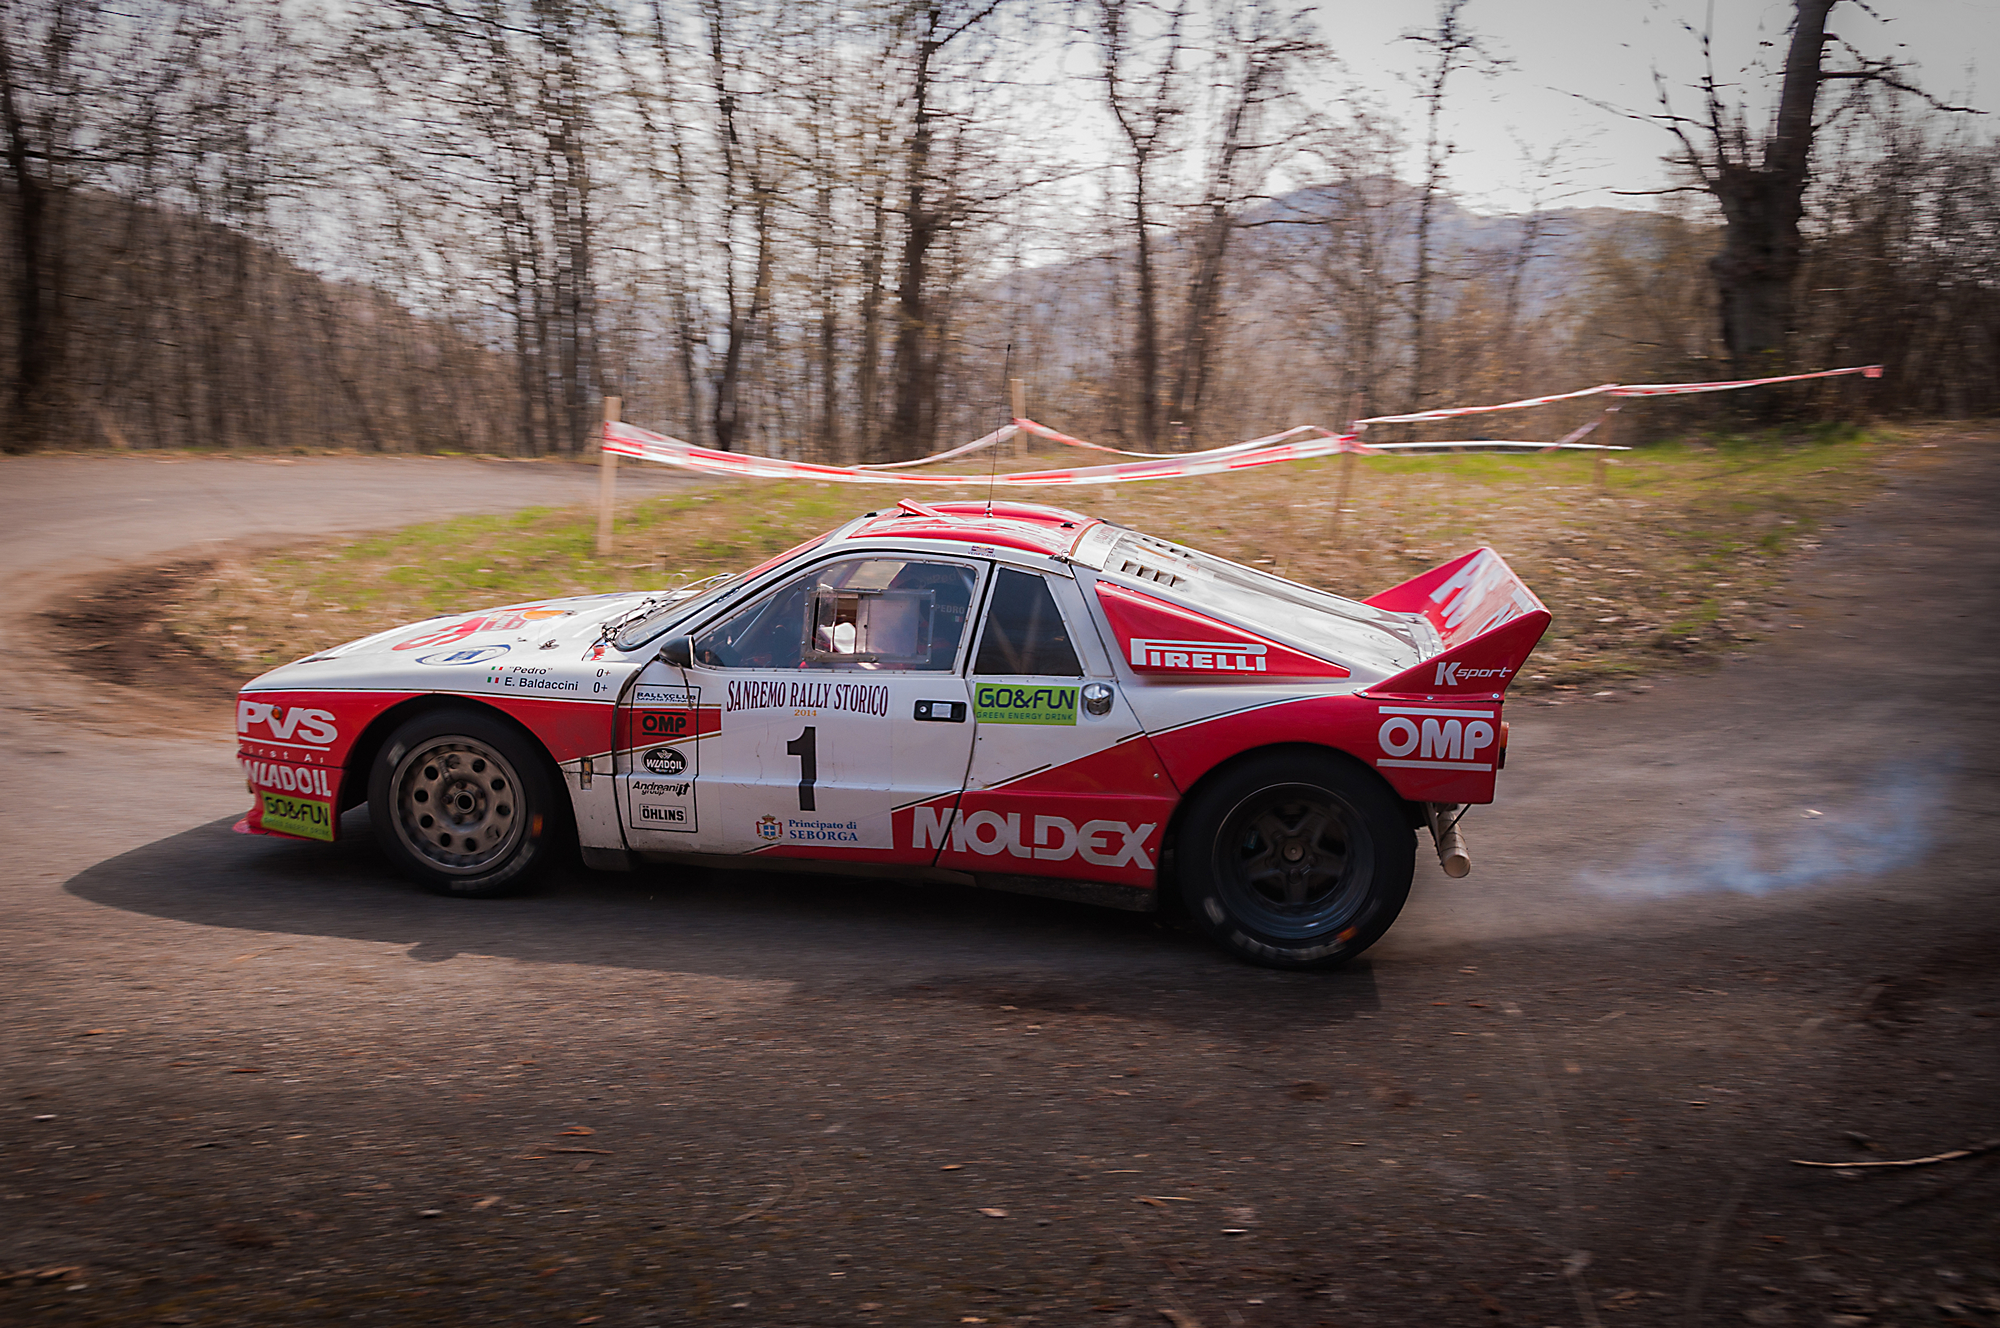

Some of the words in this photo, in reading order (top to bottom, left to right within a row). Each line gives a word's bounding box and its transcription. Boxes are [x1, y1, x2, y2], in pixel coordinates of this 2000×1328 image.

[1130, 638, 1267, 671] PIRELLI
[509, 666, 553, 675] "Pedro"
[504, 677, 515, 687] E.
[519, 677, 579, 691] Baldaccini
[726, 680, 786, 712] SANREMO
[789, 682, 832, 709] RALLY
[834, 683, 889, 717] STORICO
[978, 687, 1076, 709] GO&FUN
[794, 709, 817, 717] 2014
[976, 711, 1005, 719] GREEN
[238, 700, 338, 744] PVS
[642, 715, 687, 732] OMP
[1378, 716, 1494, 760] OMP
[646, 758, 683, 770] WLADOIL
[786, 726, 816, 811] 1
[632, 781, 680, 792] Andreani
[642, 805, 684, 821] ÖHLINS
[788, 819, 844, 831] Principato
[846, 821, 857, 830] di
[789, 830, 858, 841] SEBORGA
[912, 806, 1156, 870] MOLDEX
